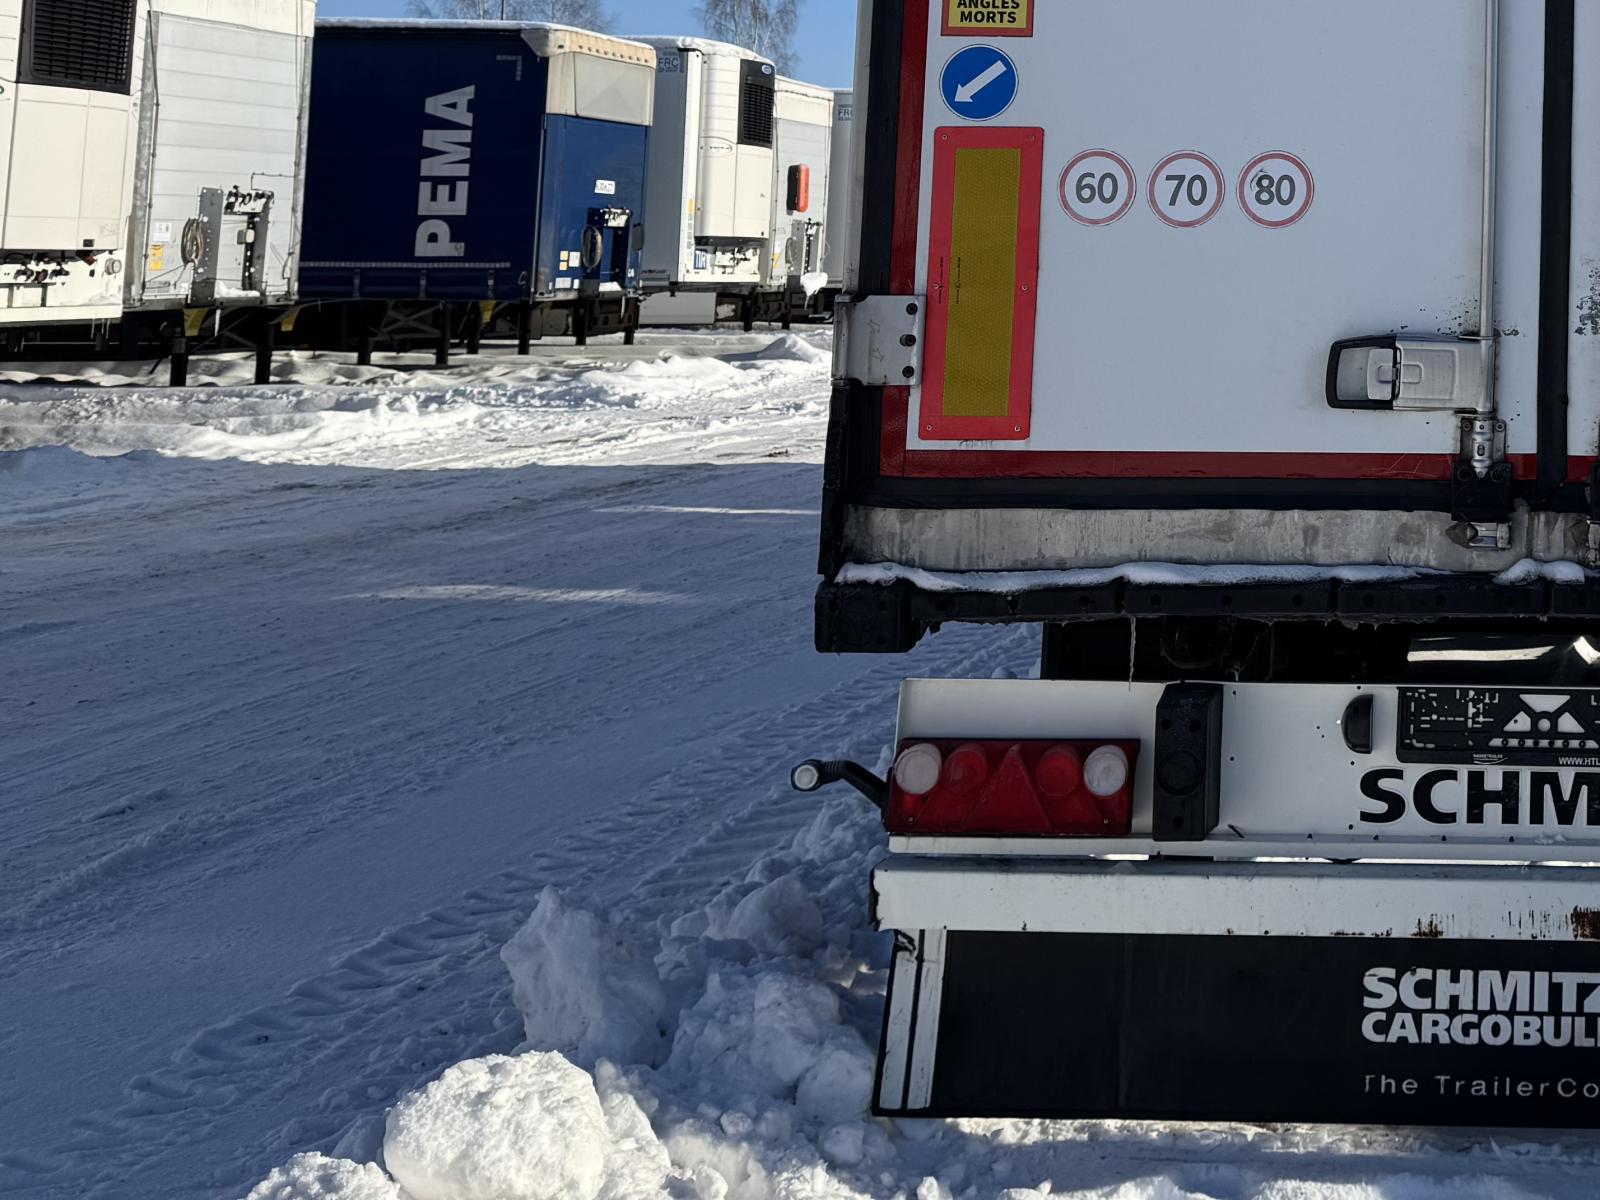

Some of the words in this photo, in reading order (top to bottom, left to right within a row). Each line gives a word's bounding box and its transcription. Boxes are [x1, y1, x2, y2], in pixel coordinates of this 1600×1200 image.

[959, 10, 1017, 24] MORTS
[414, 84, 476, 257] PEMA
[1075, 172, 1119, 205] 60
[1164, 174, 1208, 207] 70
[1253, 173, 1296, 206] 80
[1363, 1074, 1419, 1095] The
